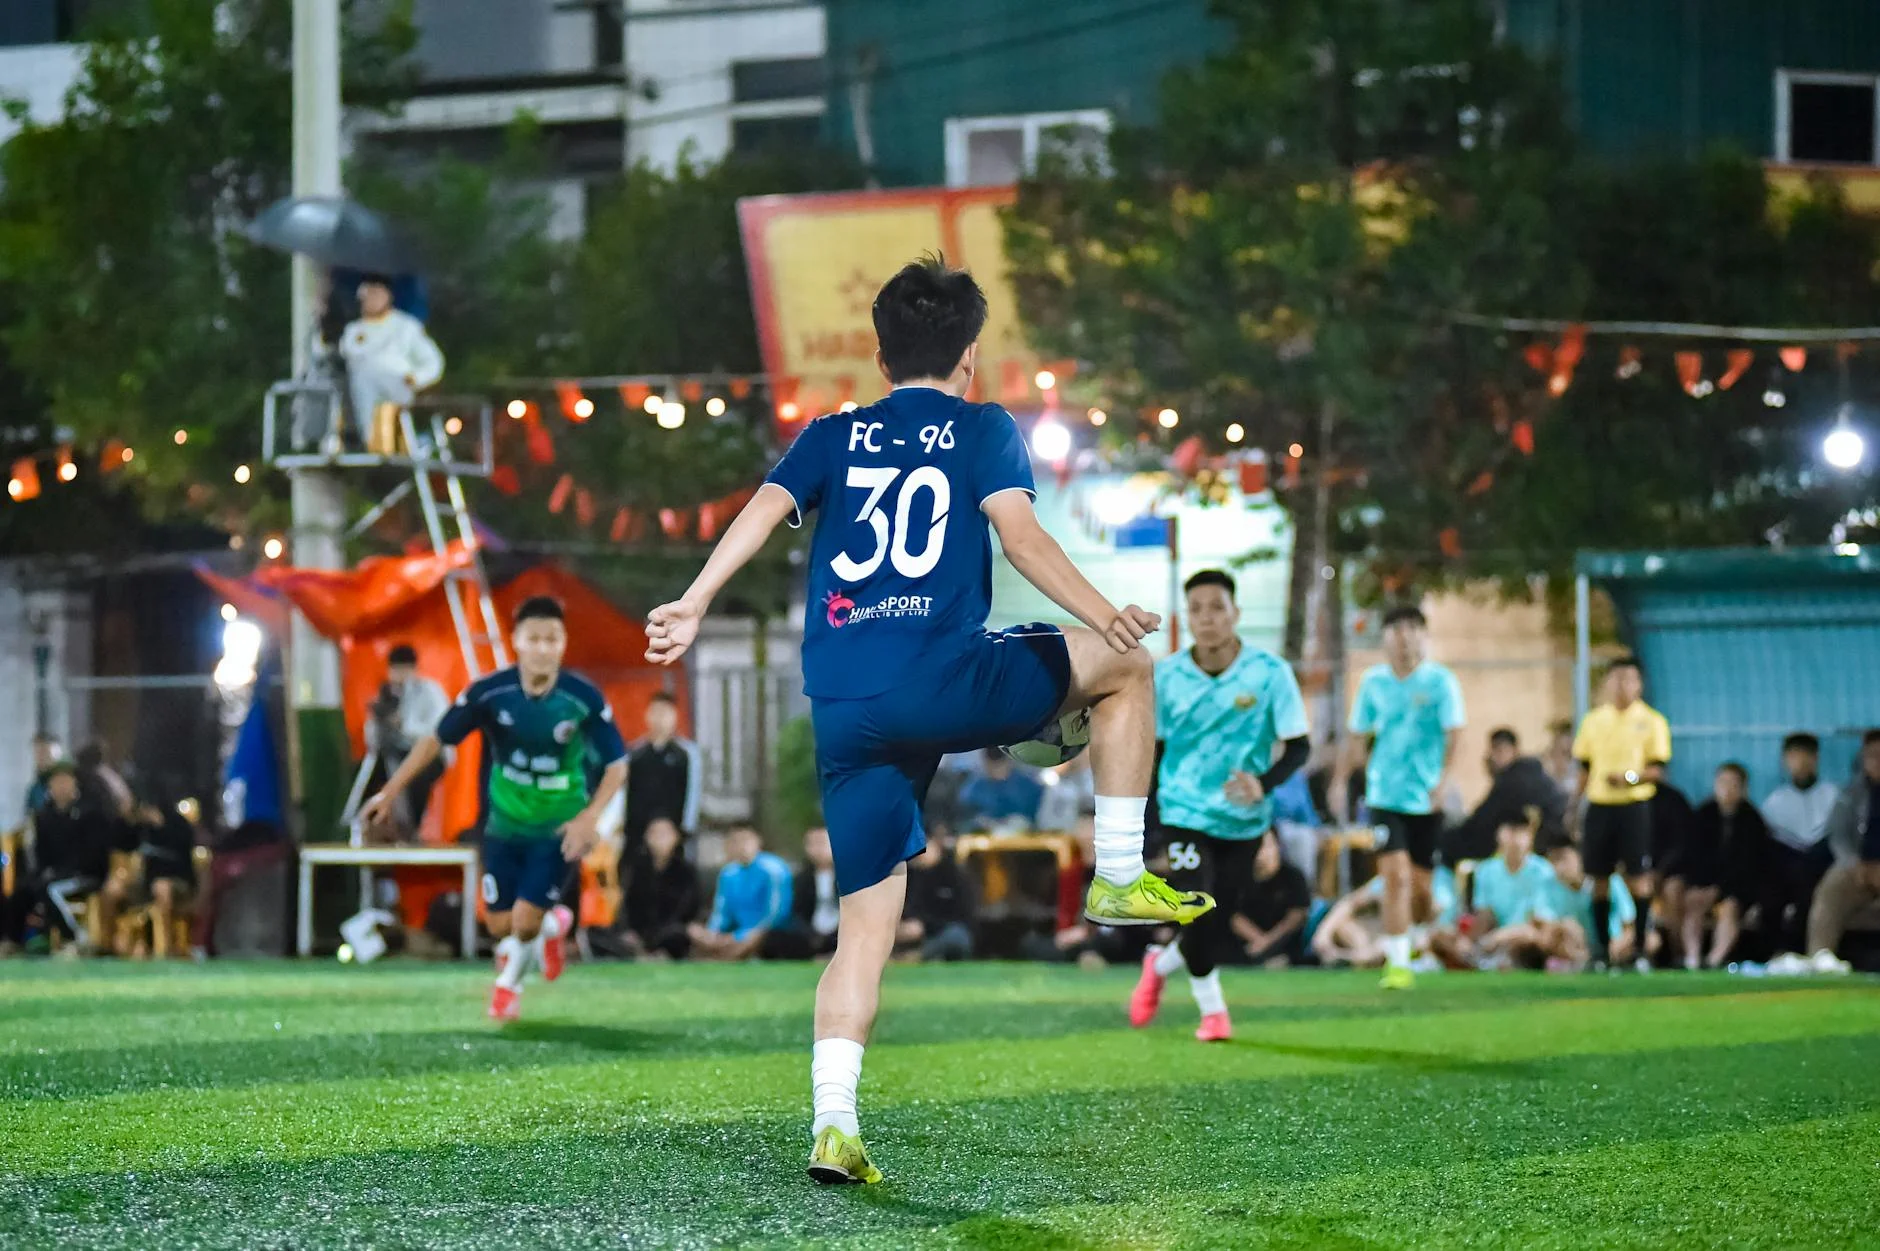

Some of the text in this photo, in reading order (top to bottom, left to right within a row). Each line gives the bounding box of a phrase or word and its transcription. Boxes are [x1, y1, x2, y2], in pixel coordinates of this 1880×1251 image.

[848, 422, 883, 452] FC
[919, 420, 954, 453] 96
[829, 465, 951, 583] 30
[1167, 841, 1202, 871] 56
